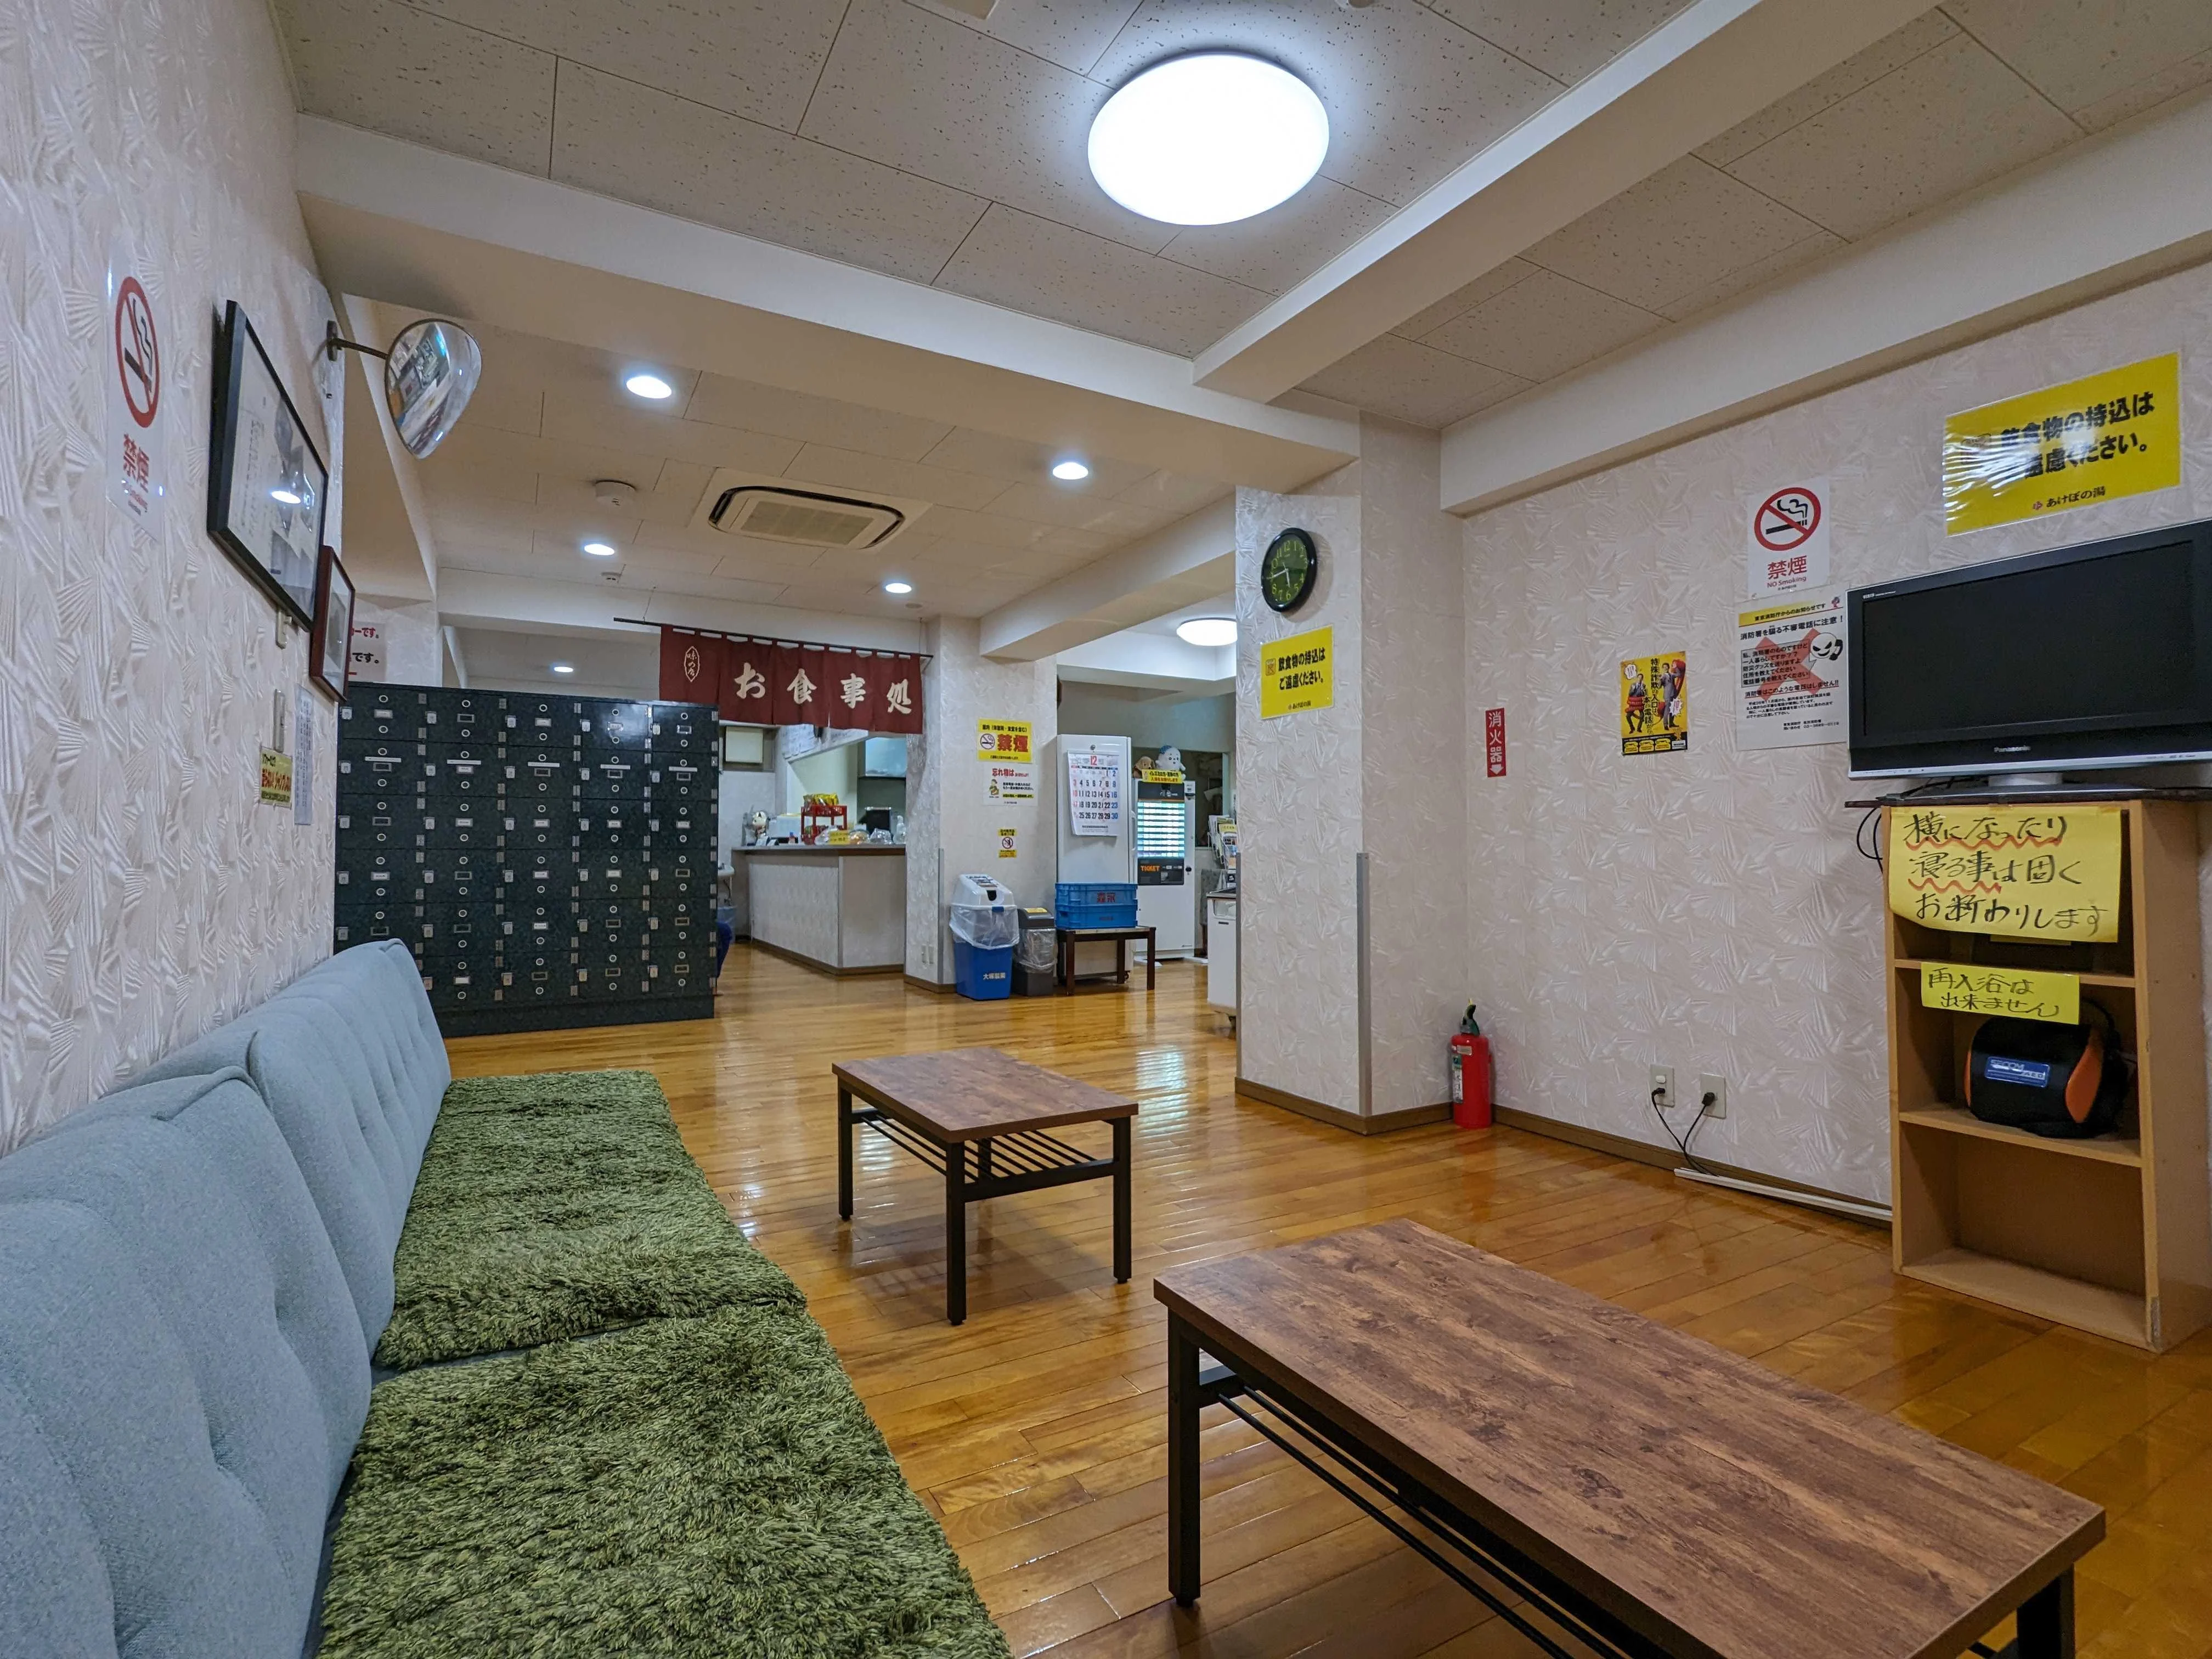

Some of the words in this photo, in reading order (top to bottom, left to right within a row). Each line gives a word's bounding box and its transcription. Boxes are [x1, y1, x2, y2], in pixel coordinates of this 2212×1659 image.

[123, 433, 149, 493] 禁煙
[2046, 486, 2106, 507] あけぼの湯
[1768, 555, 1807, 580] 禁煙
[1767, 580, 1777, 589] NO
[1779, 577, 1807, 587] Smoking
[1754, 603, 1826, 622] 東京消防庁からのお知らせです
[351, 627, 379, 639] ーです。
[1278, 647, 1325, 672] 飲食物の持込は
[734, 663, 912, 714] お食事処
[1279, 670, 1324, 690] ご遠慮ください。
[997, 734, 1028, 752] 禁煙
[1488, 711, 1502, 763] 消火器
[1091, 755, 1097, 766] 12
[1903, 811, 2068, 843] 横になったり
[1909, 850, 2082, 884] 寝る事は固く
[1915, 893, 2108, 937] お断わりします
[1928, 967, 2035, 994] 再入浴は
[1940, 992, 2059, 1017] 出来ません
